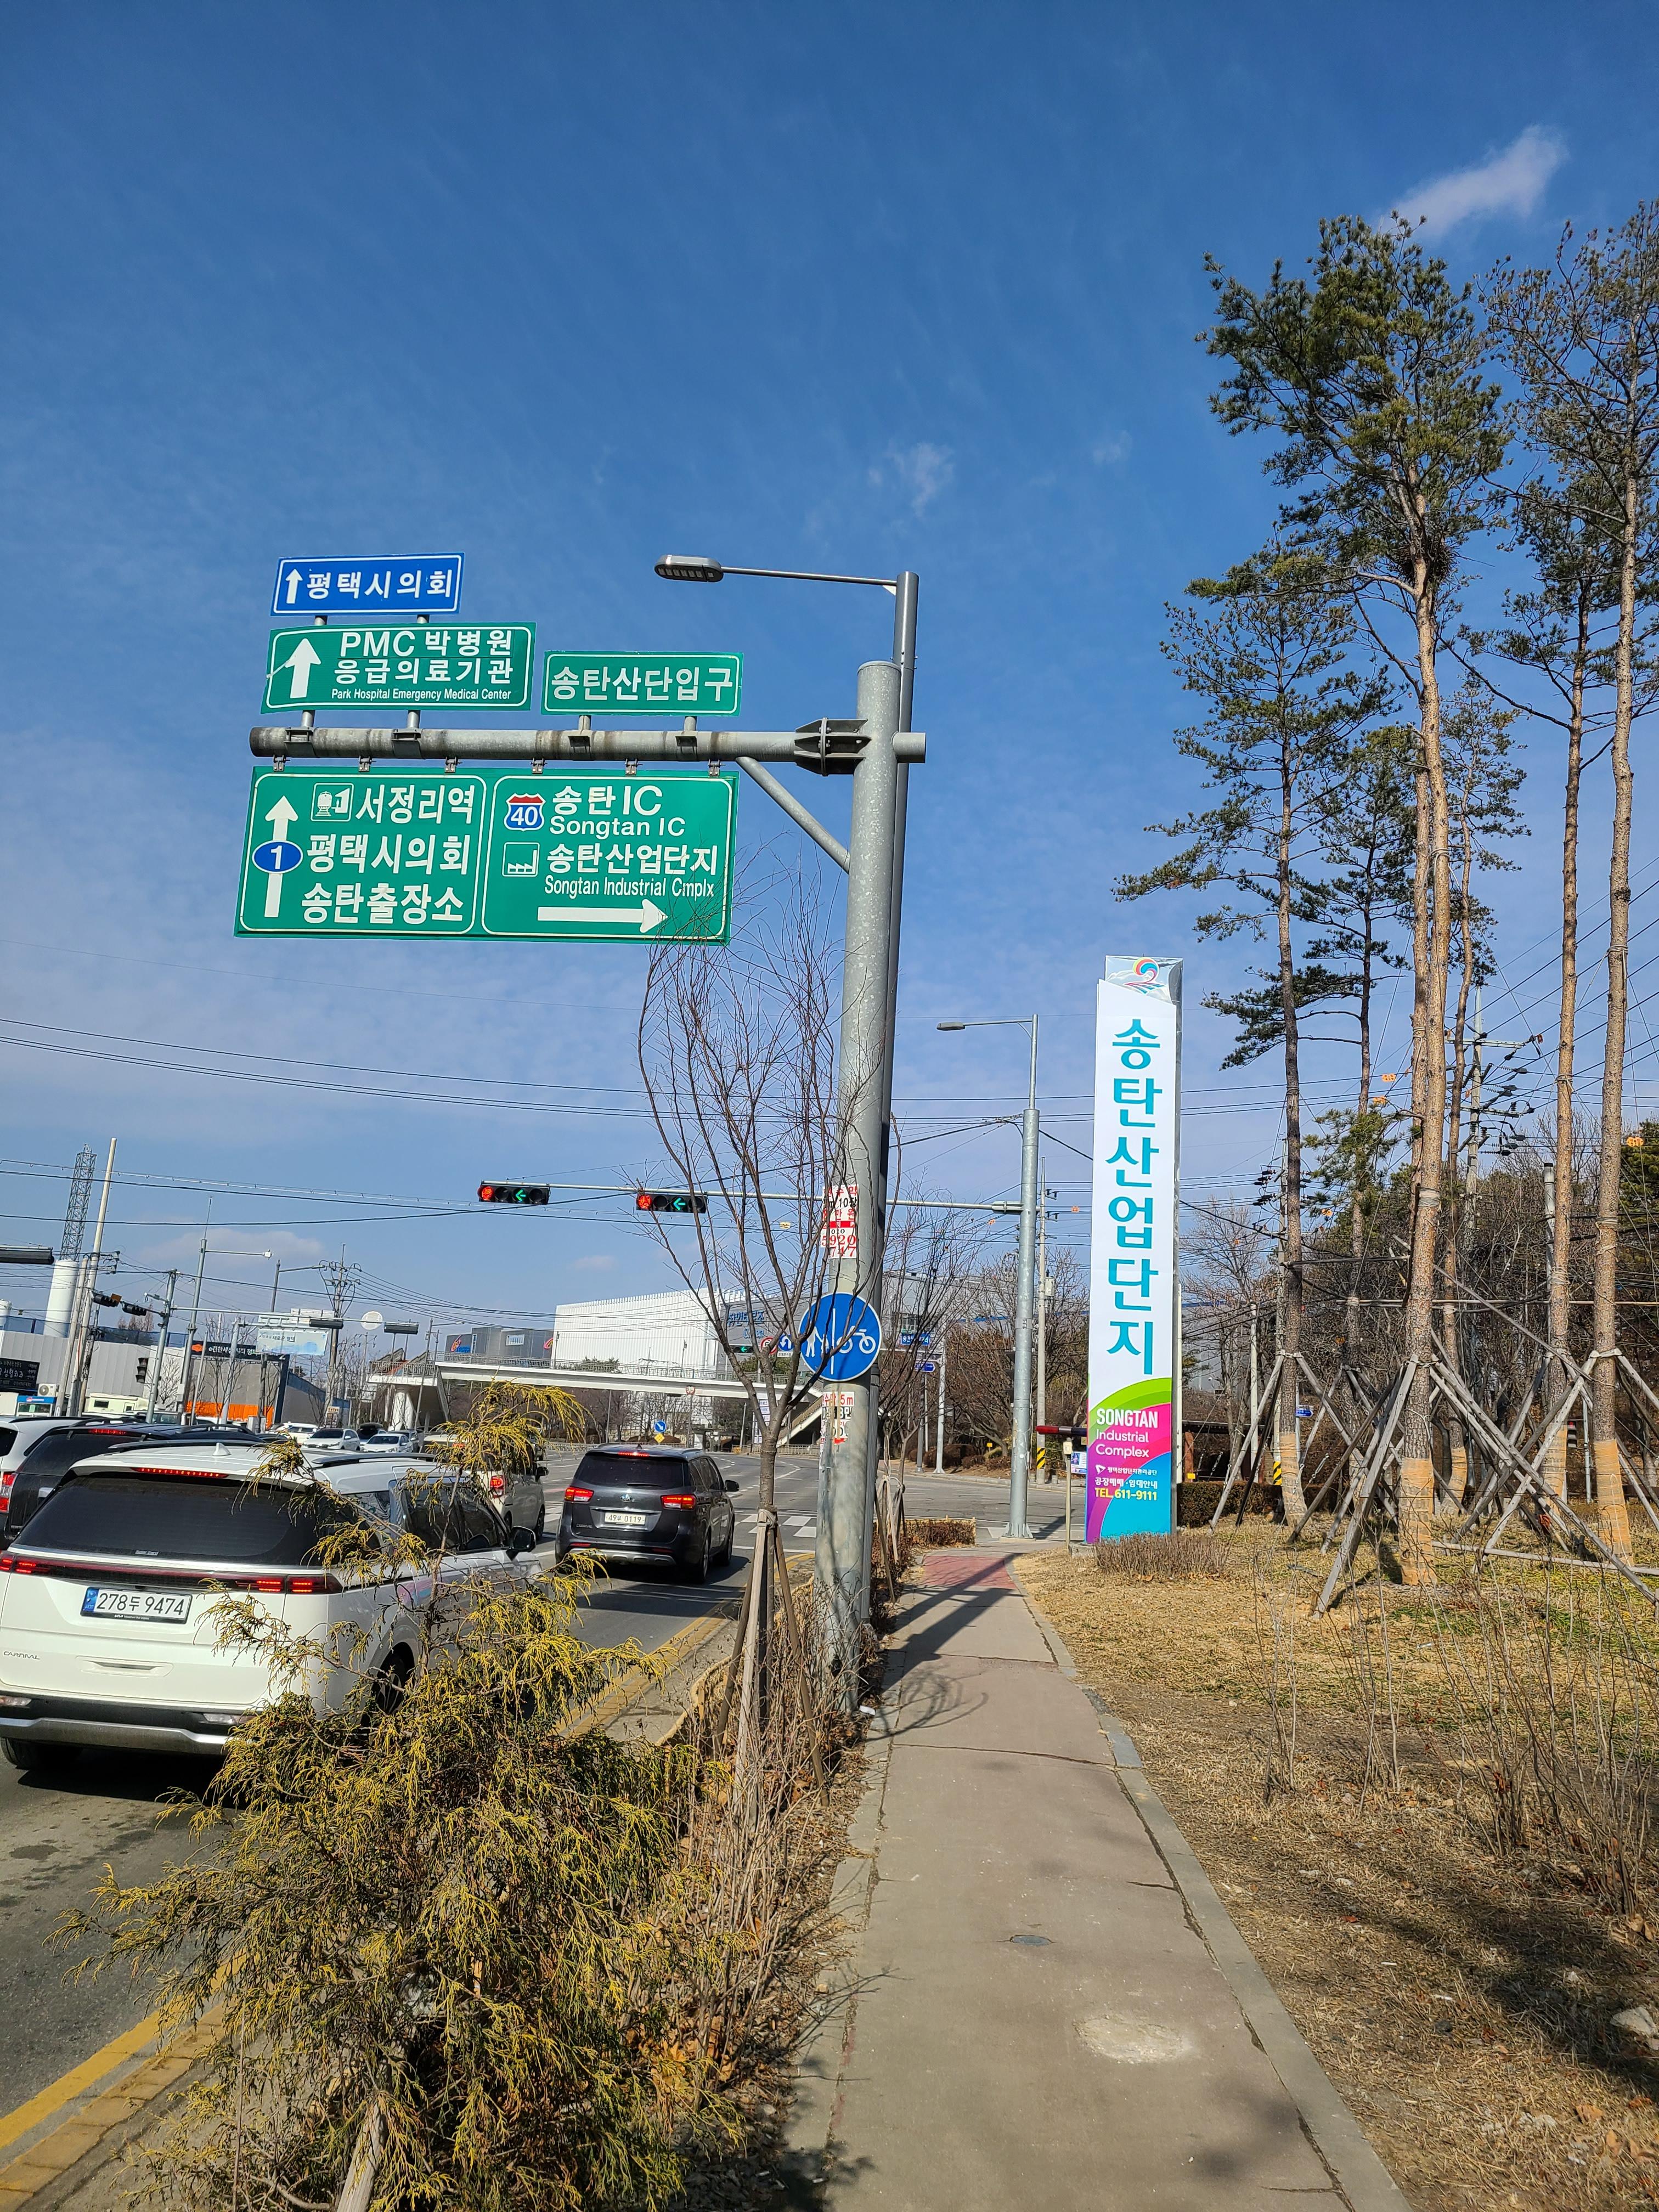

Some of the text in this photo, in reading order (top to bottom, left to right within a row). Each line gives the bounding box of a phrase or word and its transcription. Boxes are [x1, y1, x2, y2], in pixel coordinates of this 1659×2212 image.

[307, 569, 453, 600] 평택시의회
[340, 629, 512, 657] PMC 박병원
[334, 657, 514, 685] 응급의료기관
[551, 666, 733, 702] 송탄산단입구
[331, 688, 512, 702] Park Hospital Emergency Medical Center
[355, 783, 475, 825] 서정리역
[510, 806, 538, 826] 40
[549, 815, 686, 840] Songtan IC
[270, 845, 283, 870] 1
[307, 833, 471, 876] 평택시의회
[546, 842, 718, 876] 송탄산업단지
[544, 874, 714, 901] Songtan Industrial Cmplx
[301, 882, 464, 925] 송탄출장소
[1105, 1018, 1163, 1375] 송탄산업단지
[1096, 1408, 1158, 1428] SONGTAN
[1096, 1429, 1149, 1443] Industrial
[1096, 1444, 1149, 1459] Complex
[1114, 1489, 1158, 1501] 611-9111
[96, 1593, 185, 1616] 278두 9474
